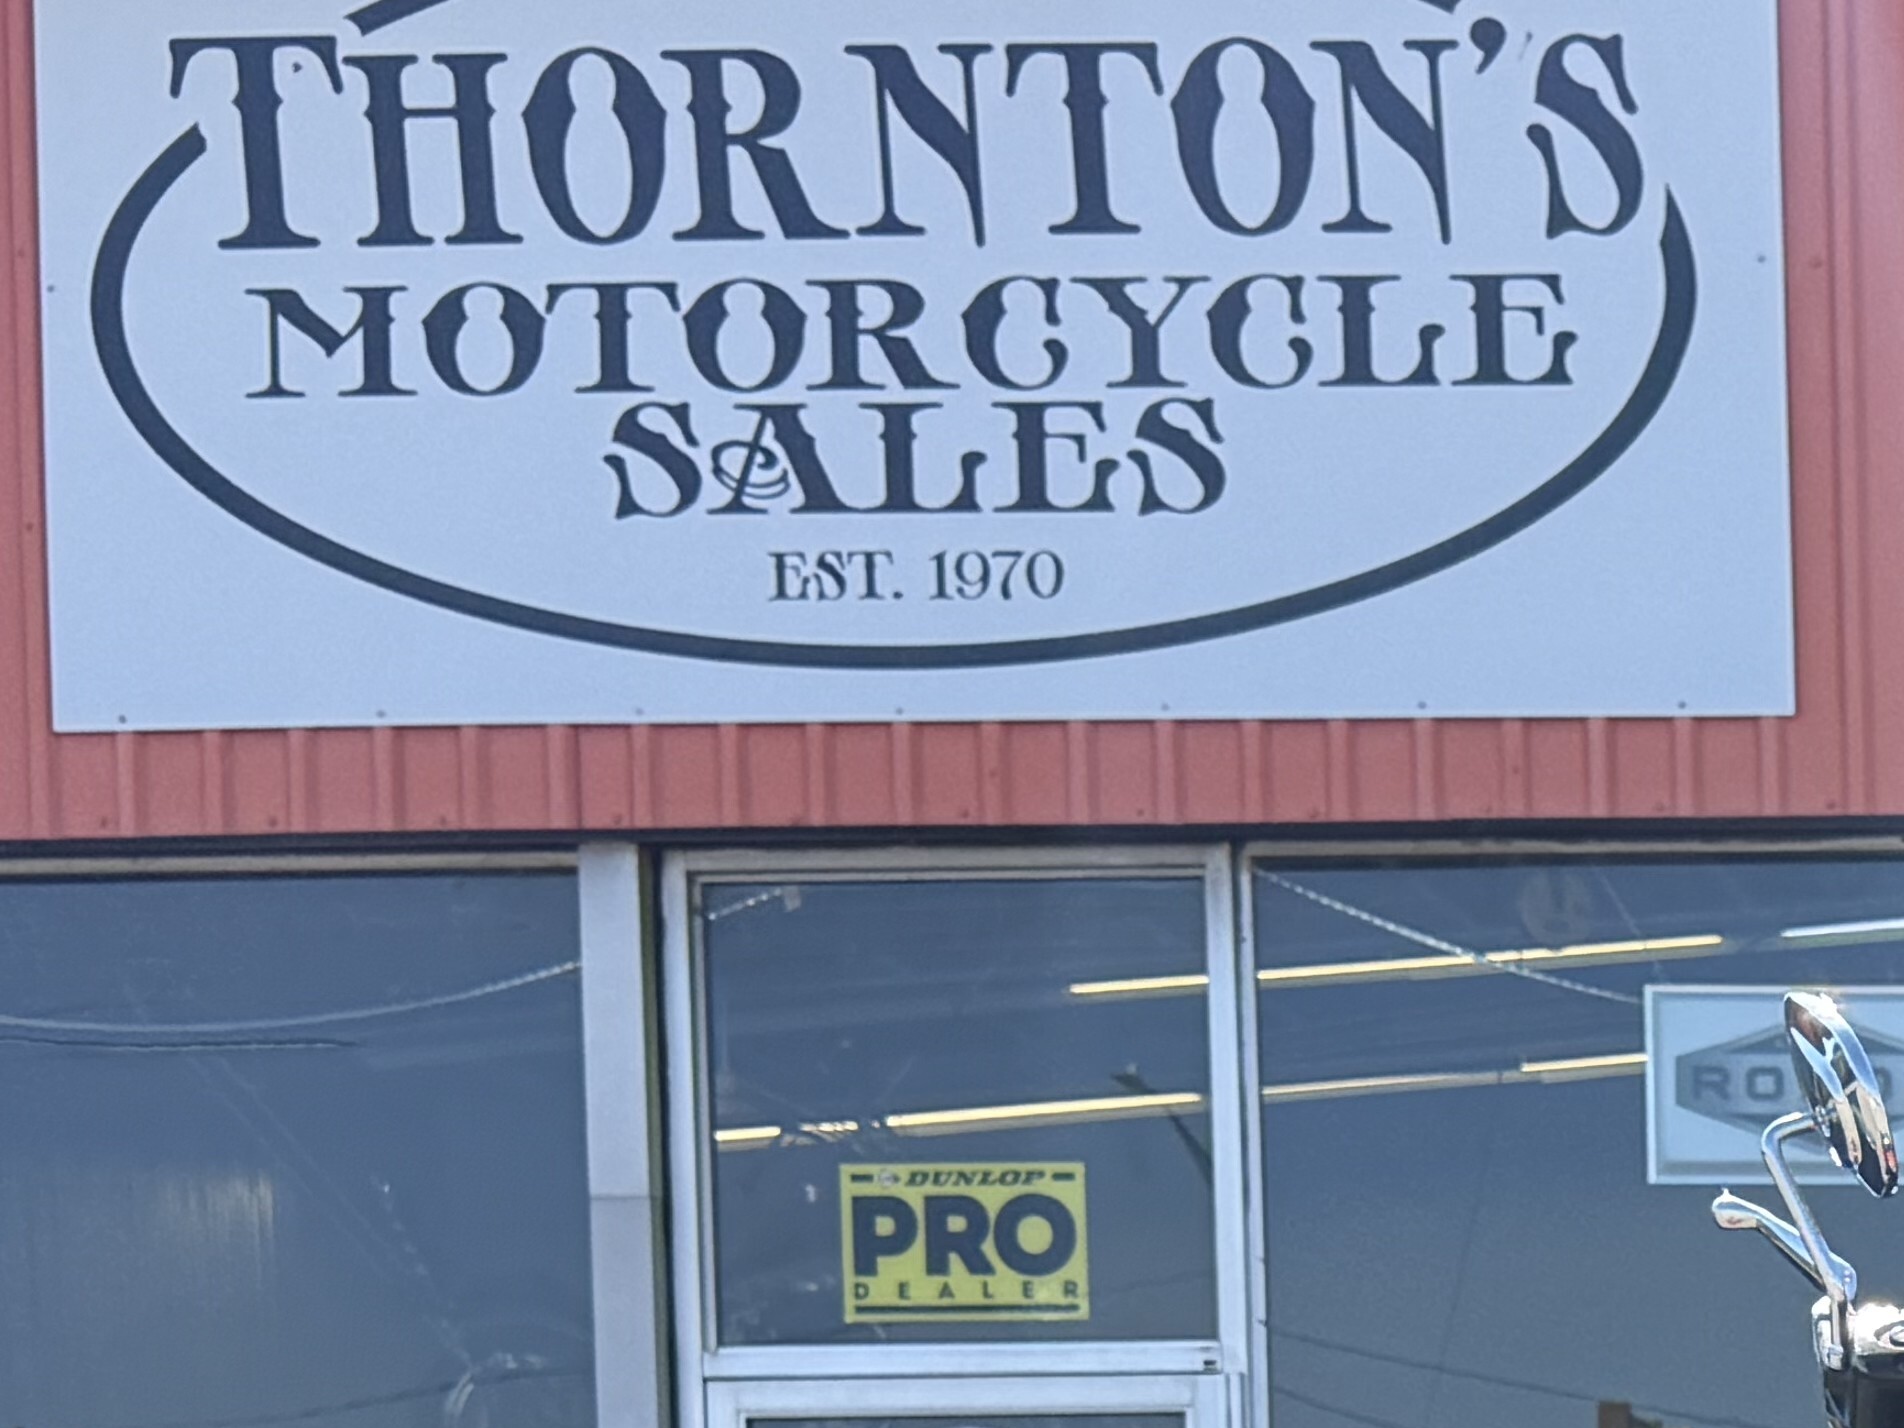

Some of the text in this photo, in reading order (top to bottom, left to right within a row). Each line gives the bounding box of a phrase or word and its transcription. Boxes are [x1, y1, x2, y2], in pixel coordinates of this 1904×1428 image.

[170, 15, 1648, 252] THORNTON'S
[244, 272, 1579, 401] MOTORCYCLE
[606, 396, 1231, 521] SALES
[765, 547, 1067, 605] EST. 1970
[904, 1169, 1047, 1188] DUNLOP
[851, 1193, 1078, 1278] PRO
[854, 1280, 1081, 1301] DEALER
